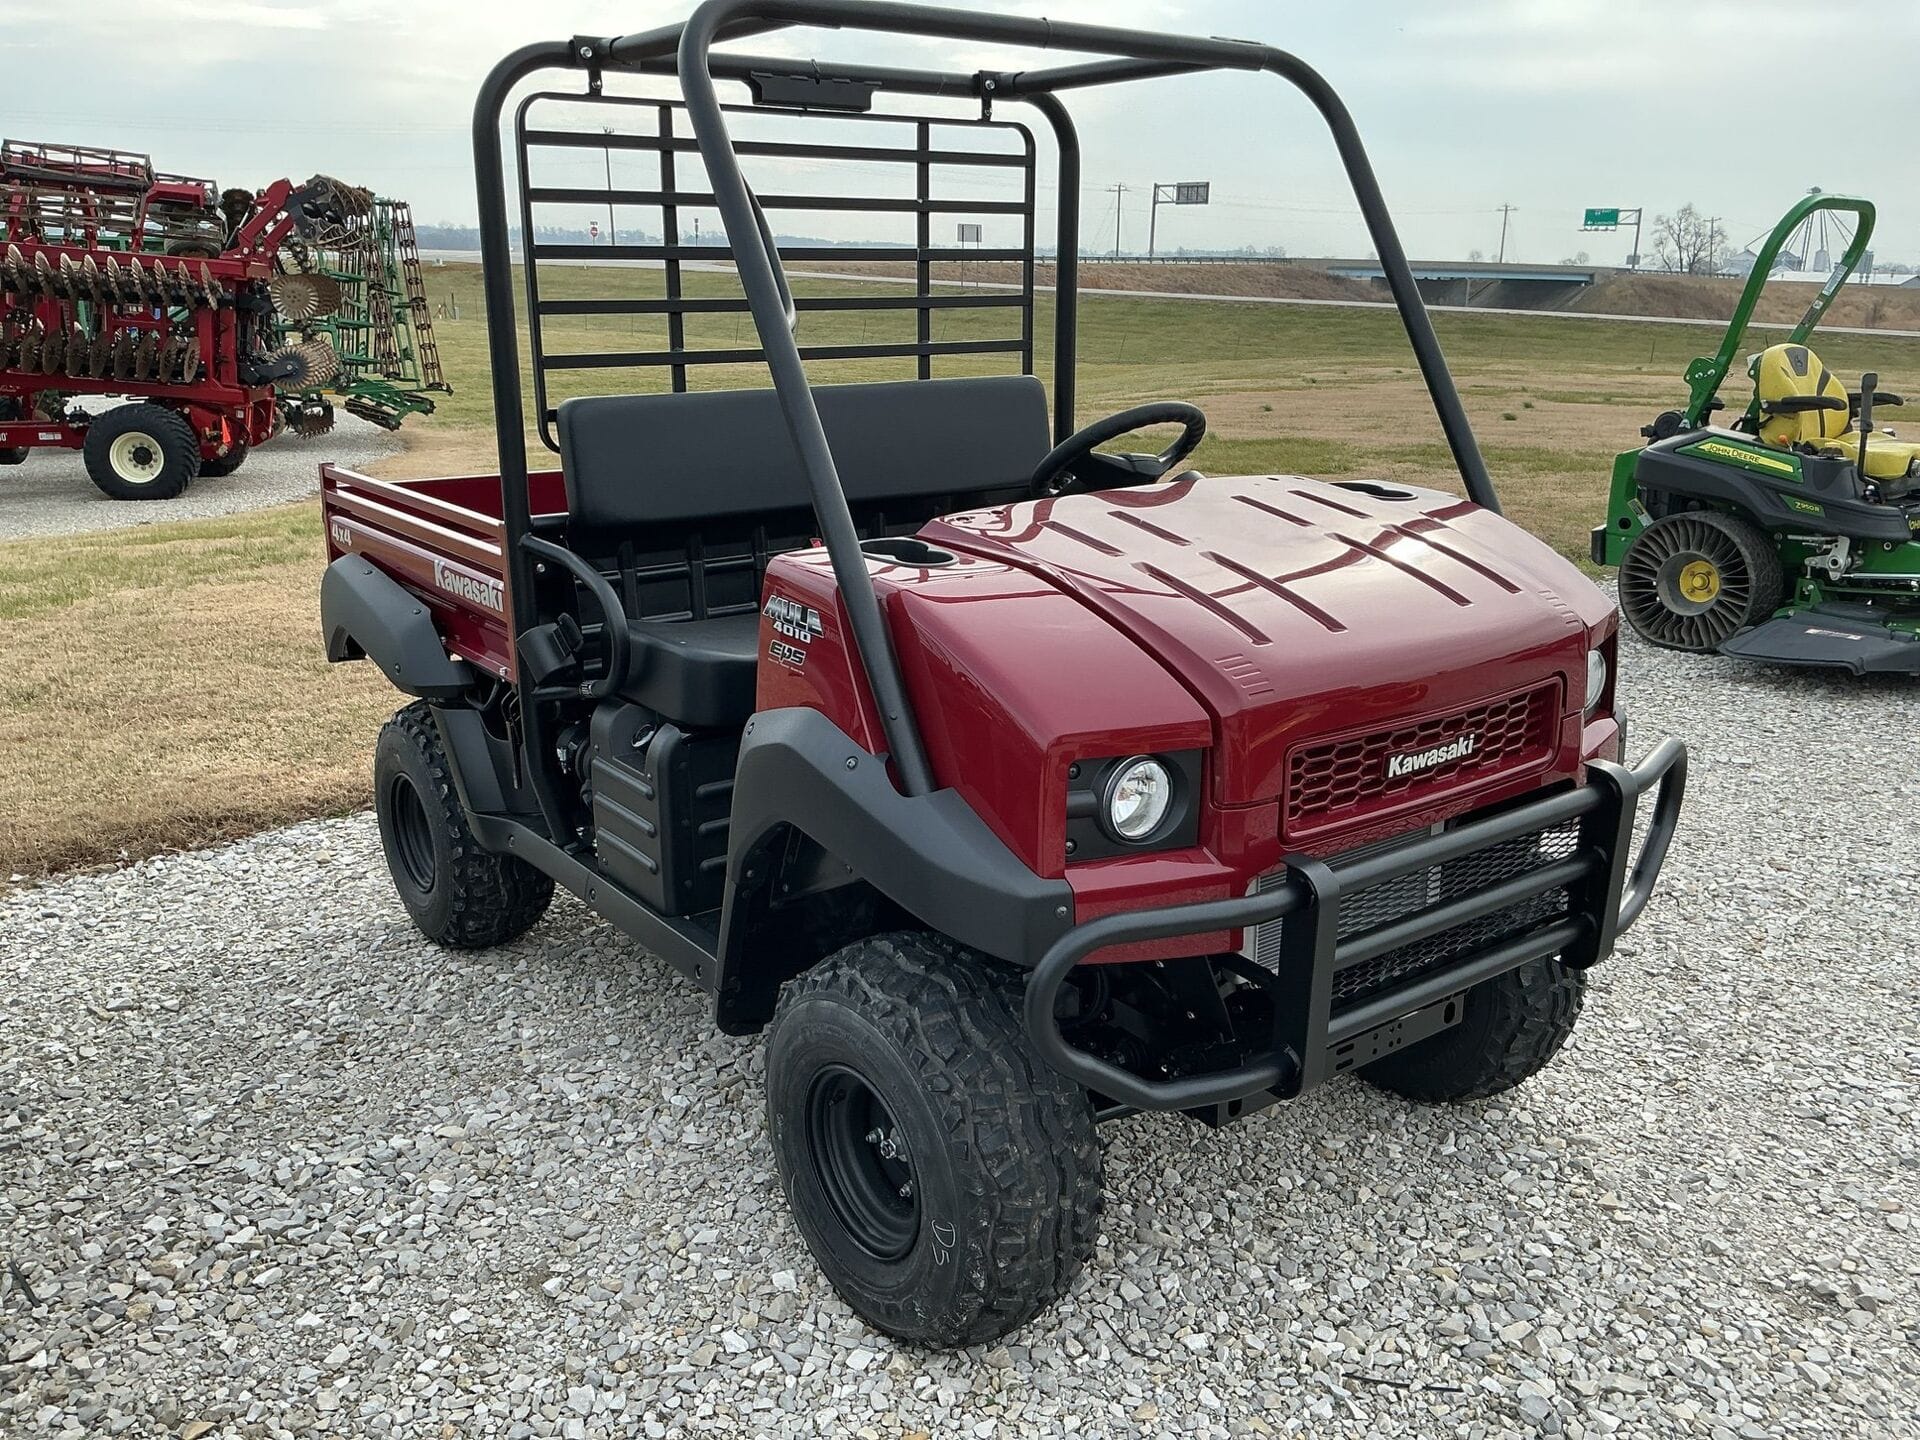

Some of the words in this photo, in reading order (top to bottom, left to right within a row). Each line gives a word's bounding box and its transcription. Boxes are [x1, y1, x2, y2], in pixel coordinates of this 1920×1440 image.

[1707, 444, 1731, 456] JOHN
[1732, 449, 1760, 463] DEERE
[332, 523, 352, 547] 4x4
[433, 559, 504, 612] Kawasaki
[763, 595, 824, 638] MULE
[773, 621, 811, 643] 4010
[1388, 734, 1475, 778] Kawasaki
